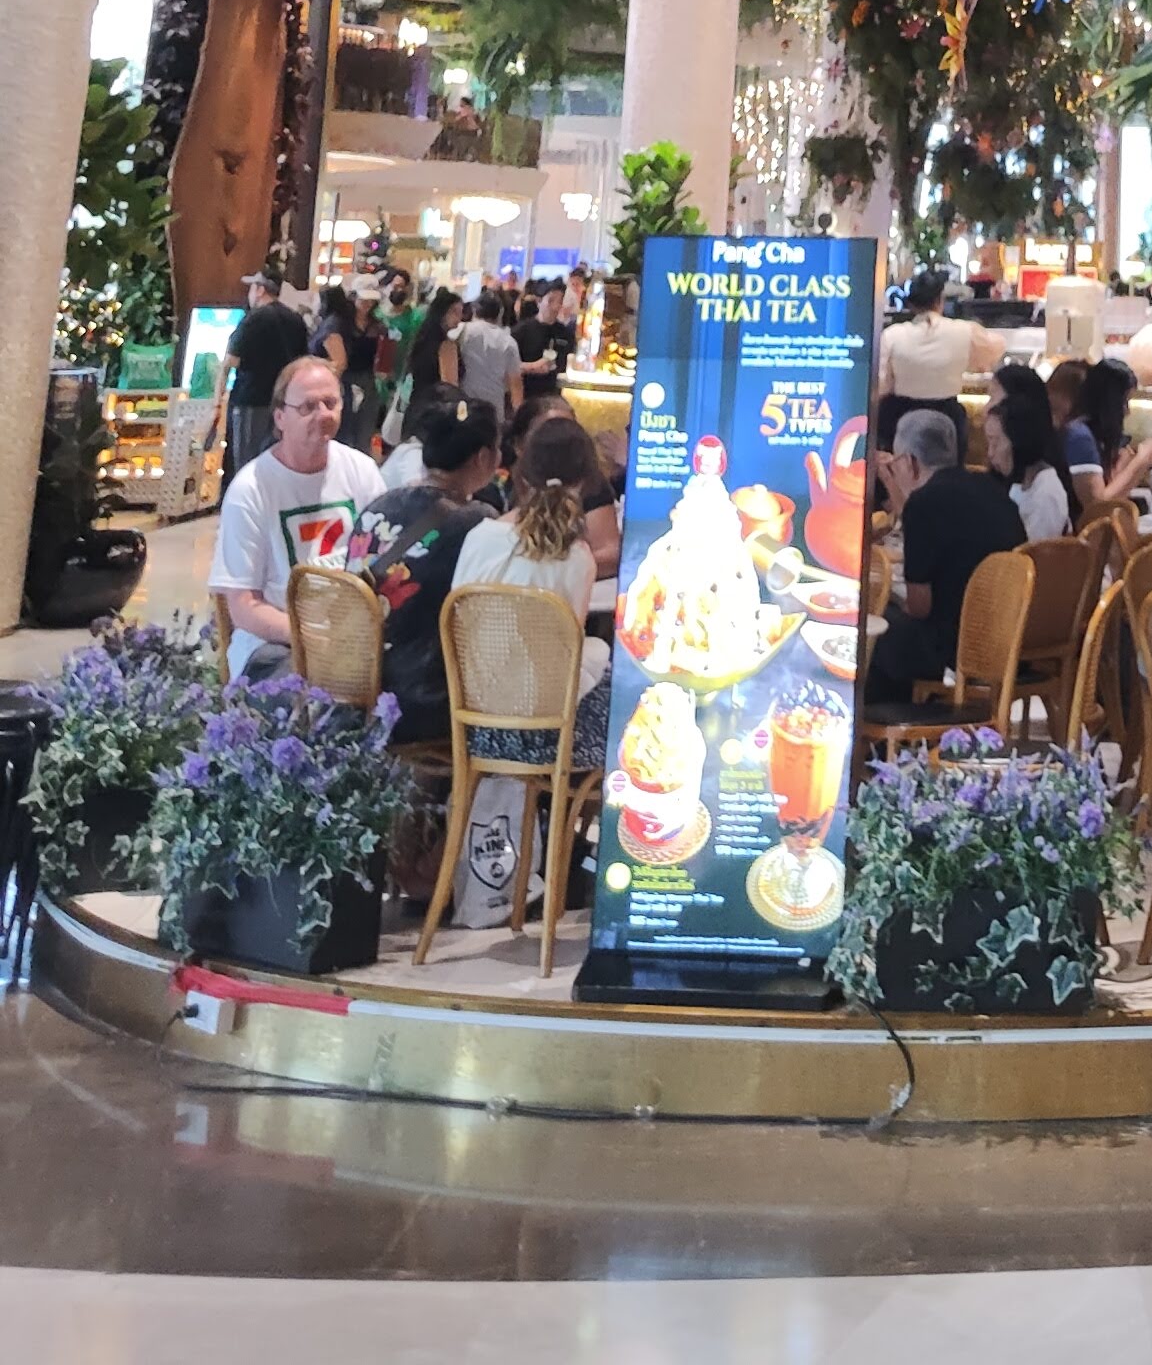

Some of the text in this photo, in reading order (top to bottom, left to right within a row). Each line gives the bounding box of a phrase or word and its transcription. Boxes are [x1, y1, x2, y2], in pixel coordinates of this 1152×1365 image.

[712, 240, 806, 269] Pang Cha
[667, 272, 852, 299] WORLD CLASS
[696, 298, 818, 324] THAI TEA
[760, 393, 833, 437] 5 TEA
